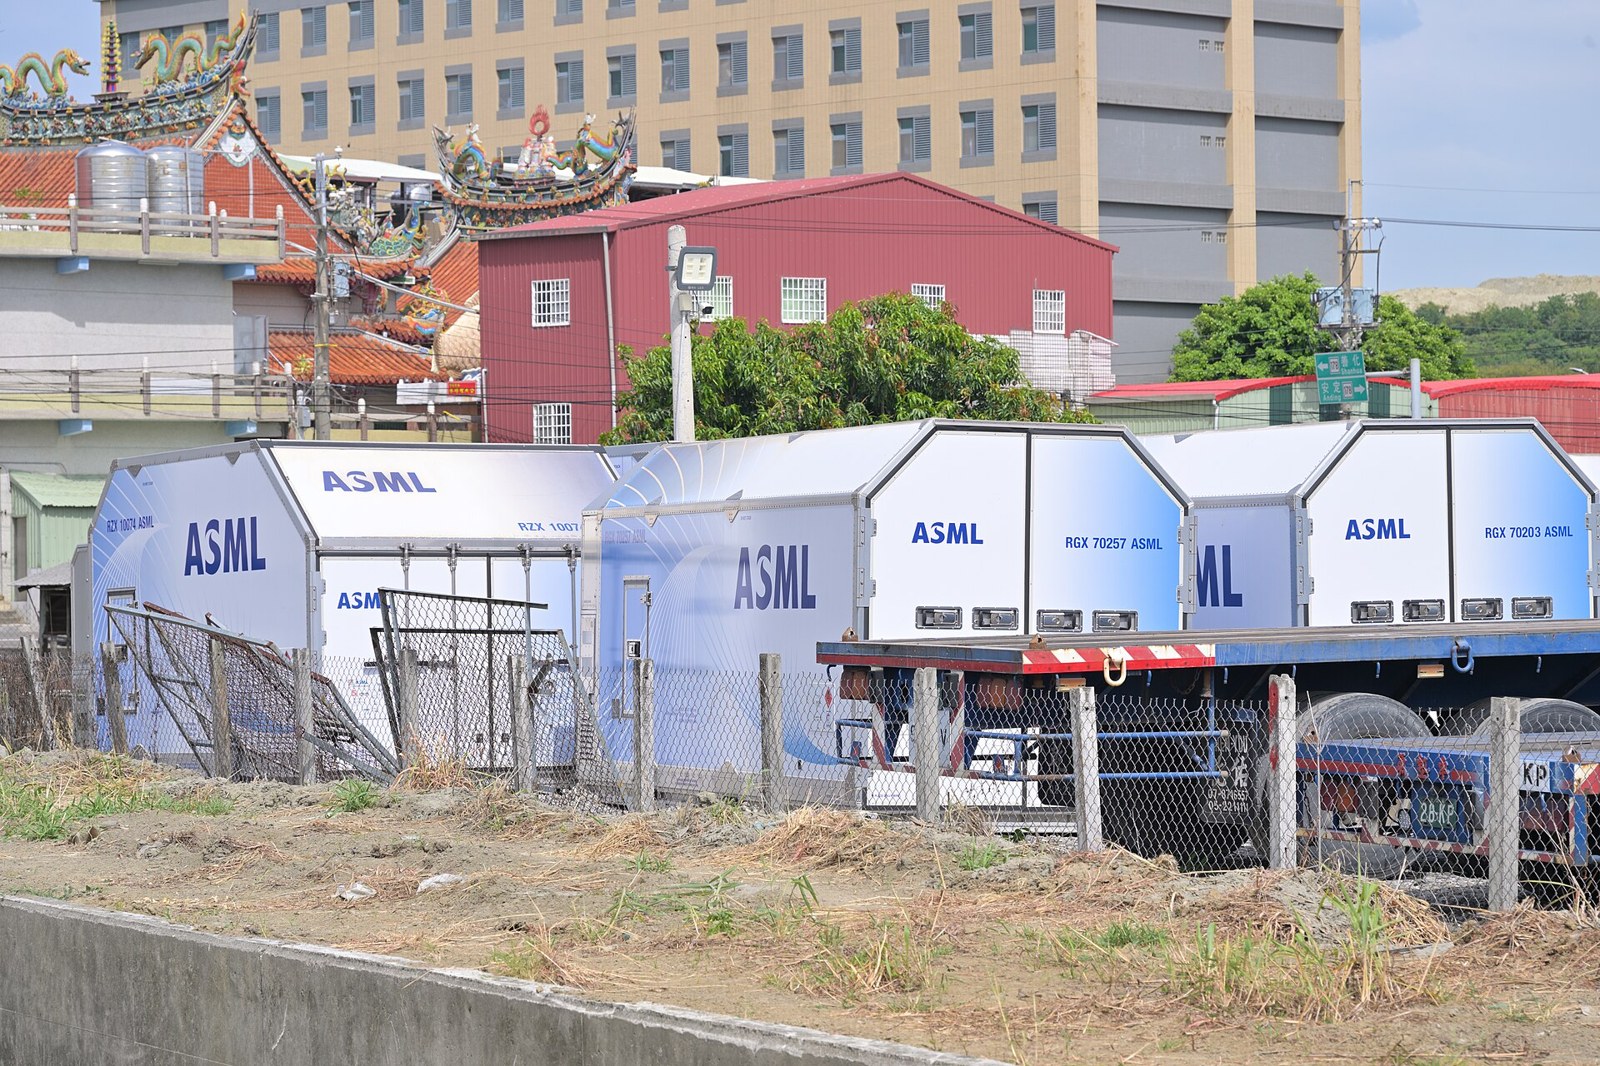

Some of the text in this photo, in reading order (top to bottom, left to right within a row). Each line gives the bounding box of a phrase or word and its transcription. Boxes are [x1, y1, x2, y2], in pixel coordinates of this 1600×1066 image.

[1321, 381, 1341, 394] 安定
[1323, 394, 1341, 402] Anding
[323, 470, 436, 493] ASML
[107, 516, 154, 533] RZX 10074 ASML
[518, 522, 583, 532] RZX 1007
[911, 521, 984, 545] ASML
[1346, 518, 1411, 541] ASML
[1485, 525, 1574, 539] RGX 70203 ASML
[184, 516, 266, 577] ASML
[1065, 536, 1164, 551] RGX 70257 ASML
[734, 544, 817, 611] ASML
[337, 592, 389, 610] ASM
